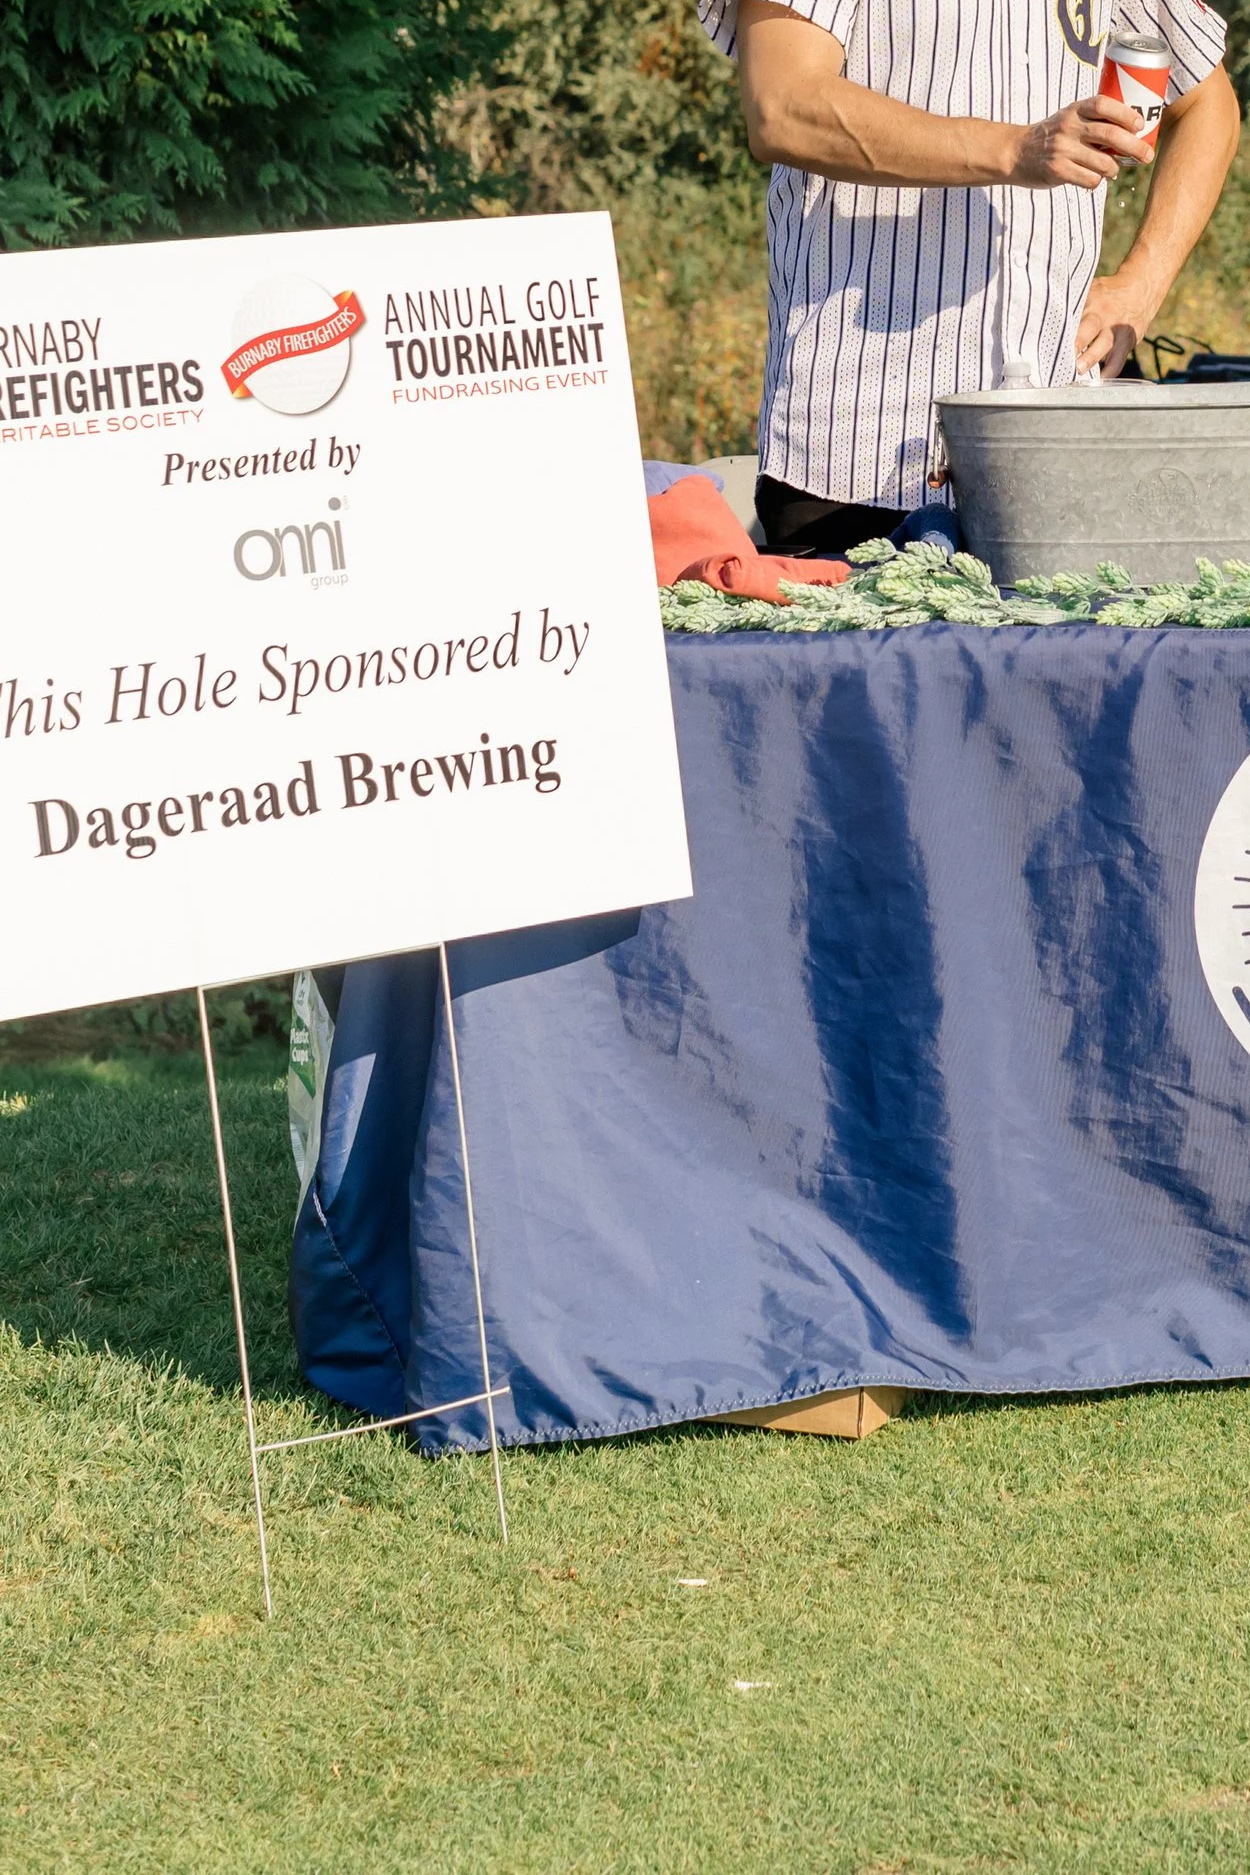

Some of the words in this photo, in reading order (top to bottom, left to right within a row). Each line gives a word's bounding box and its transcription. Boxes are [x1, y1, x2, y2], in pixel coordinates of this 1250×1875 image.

[385, 285, 516, 335] ANNUAL
[527, 277, 600, 322] GOLF
[0, 318, 102, 369] RNABY
[227, 337, 282, 379] BURNABY
[283, 306, 357, 353] FIREFIGHTERS
[386, 323, 604, 381] TOURNAMENT
[392, 377, 540, 404] FUNDRAISING
[546, 370, 609, 390] EVENT
[0, 419, 101, 444] RITABLE
[106, 409, 204, 433] SOCIETY
[161, 438, 317, 486] Presented
[328, 436, 361, 475] by
[233, 497, 346, 581] onni
[311, 573, 349, 590] group
[0, 678, 83, 738] his
[104, 653, 237, 724] Hole
[258, 611, 521, 716] Sponsored
[539, 607, 590, 676] by
[28, 760, 322, 859] Dageraad
[334, 732, 561, 809] Brewing
